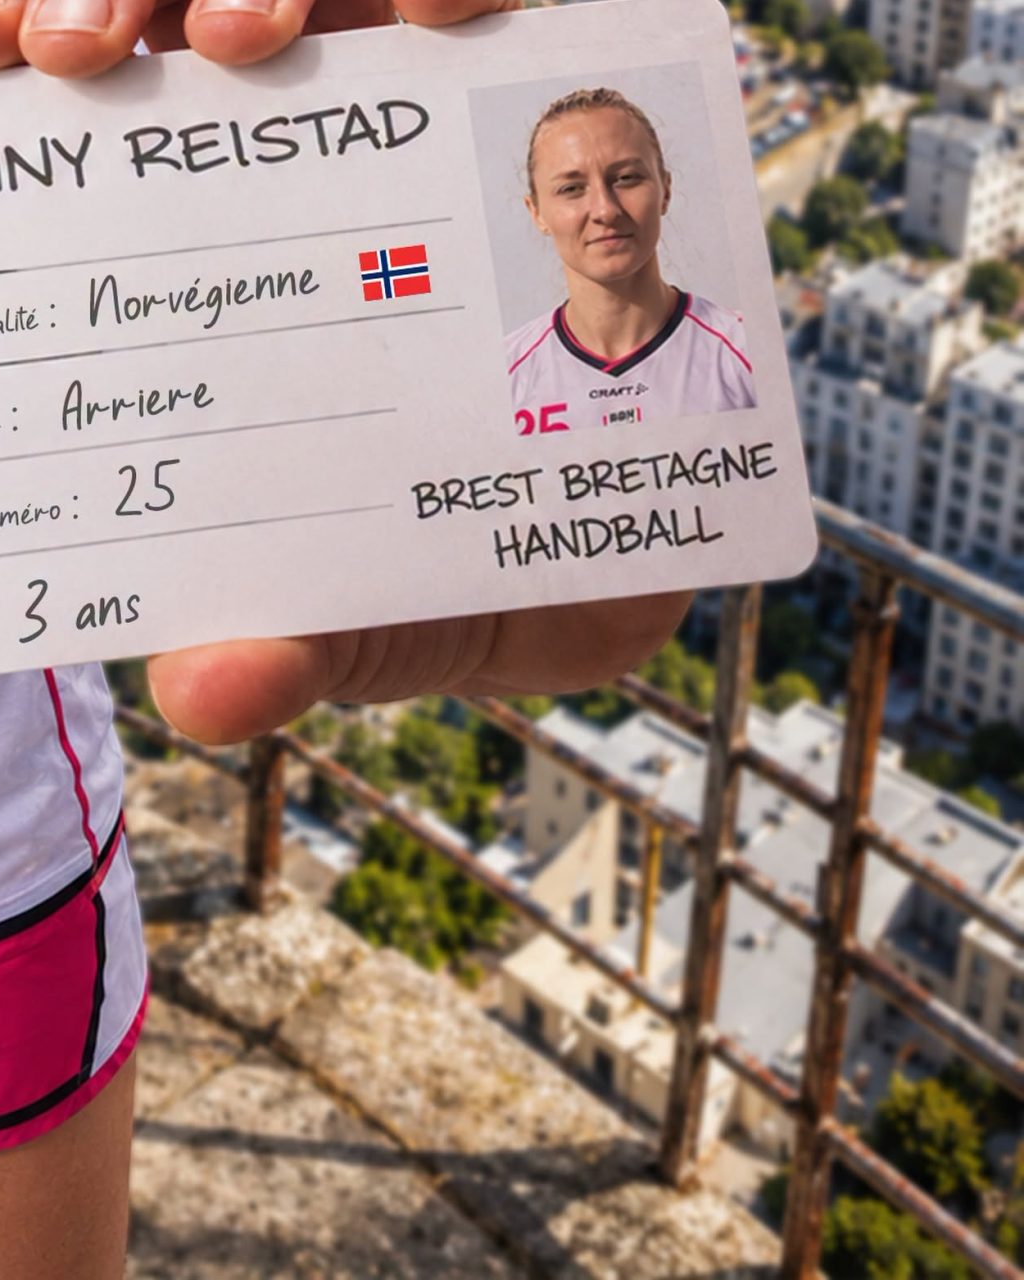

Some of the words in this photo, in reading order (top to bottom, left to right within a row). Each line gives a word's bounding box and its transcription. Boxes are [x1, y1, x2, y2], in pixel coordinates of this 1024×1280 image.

[124, 101, 429, 177] REISTAD
[90, 270, 319, 329] Norvégienne
[63, 381, 213, 430] Arriere
[116, 459, 179, 515] 25
[411, 469, 542, 519] BREST
[559, 442, 777, 500] BRETAGNE
[494, 506, 724, 568] HANDBALL
[20, 580, 47, 643] 3
[76, 595, 139, 629] ans
